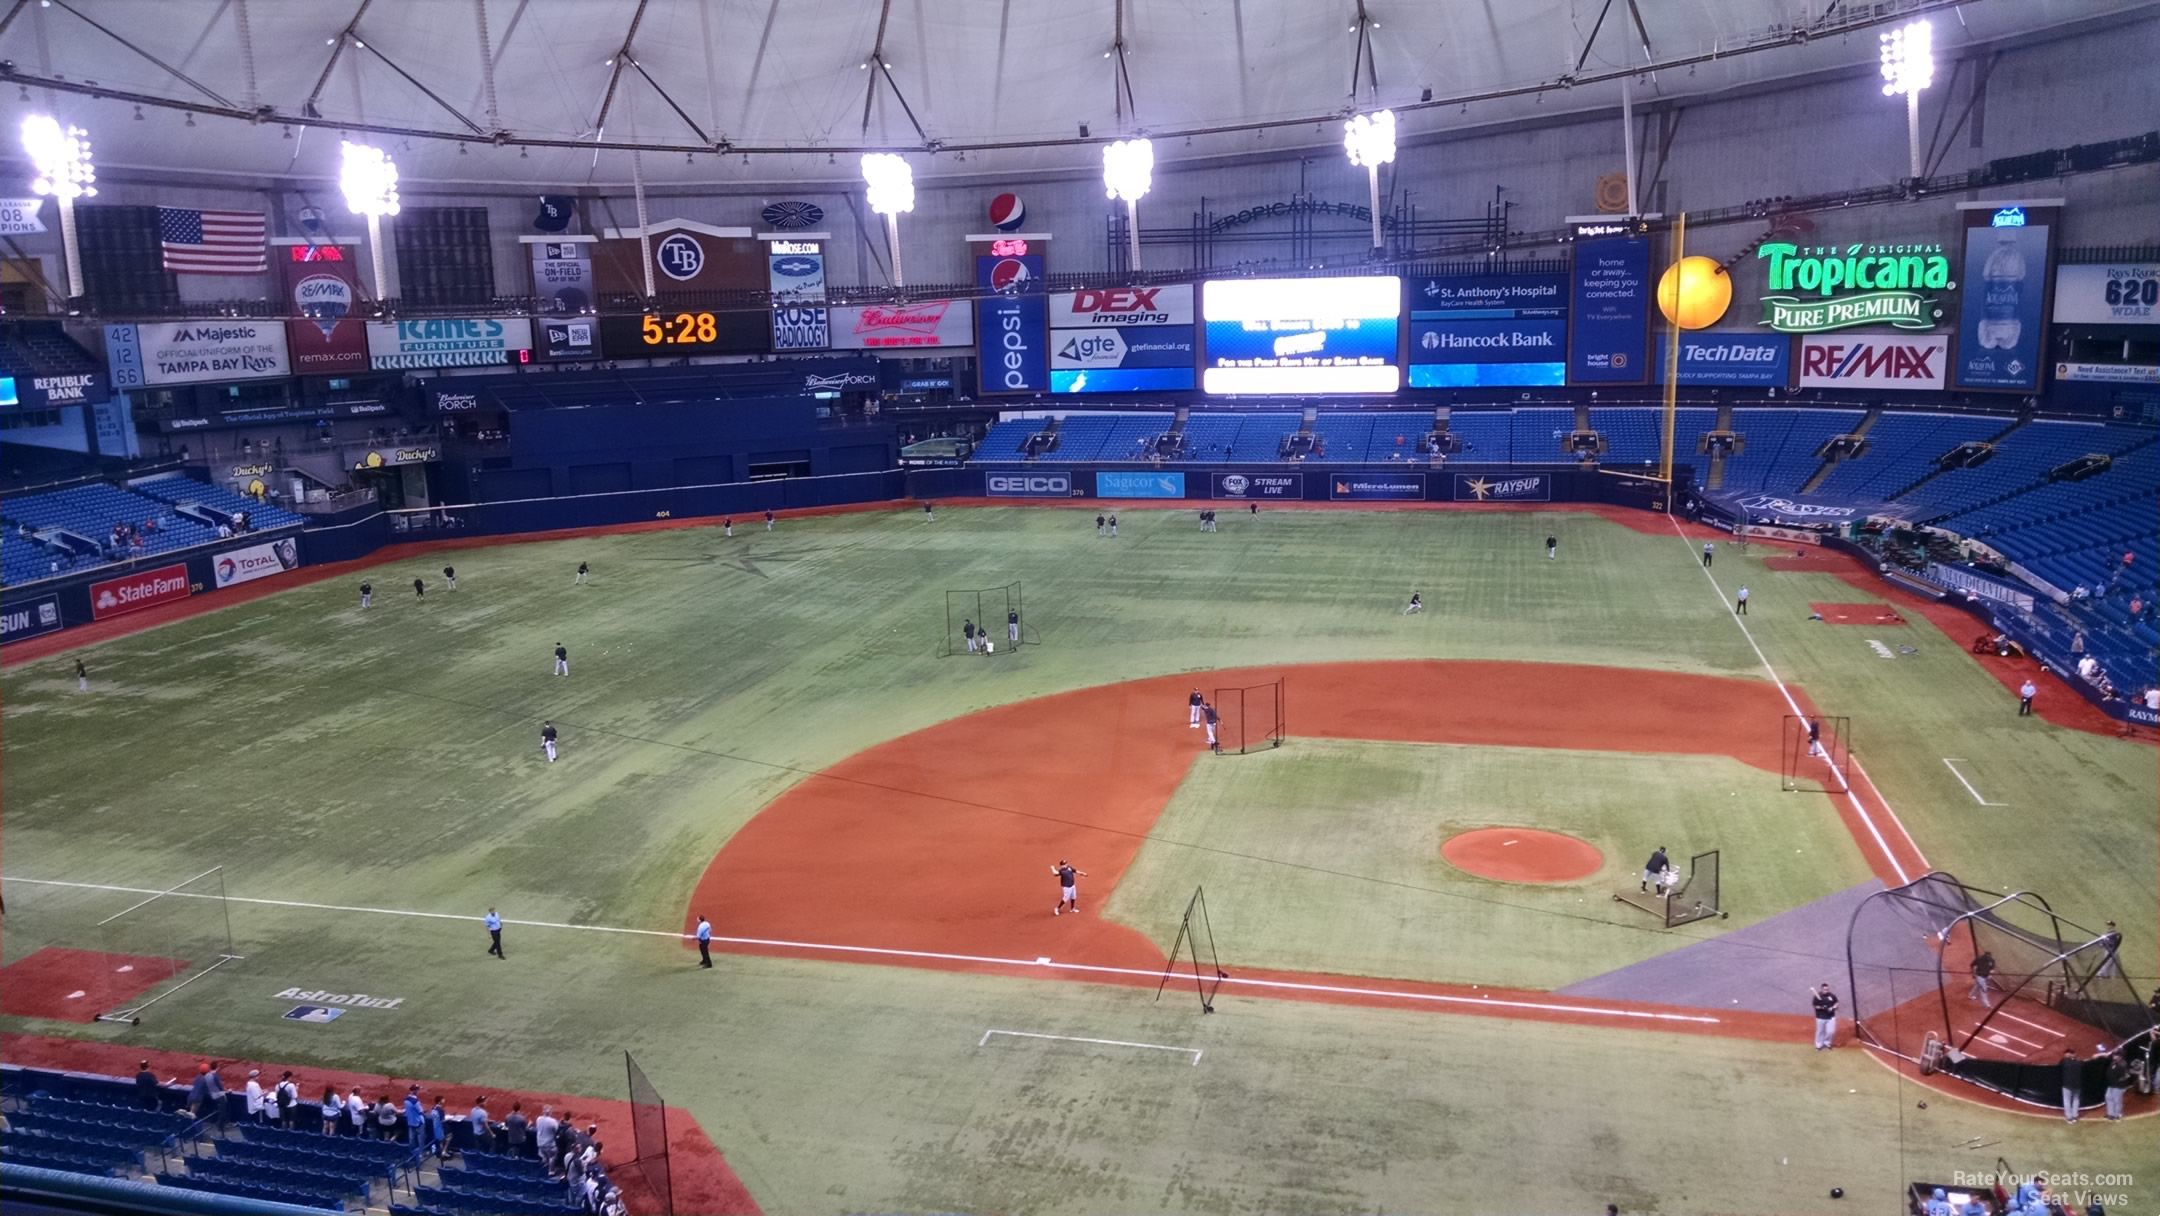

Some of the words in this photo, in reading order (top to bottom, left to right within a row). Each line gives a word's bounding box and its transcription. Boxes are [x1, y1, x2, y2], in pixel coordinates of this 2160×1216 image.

[1212, 200, 1332, 233] TROPICANA
[1578, 226, 1605, 236] bright
[1803, 247, 1837, 255] THE
[1869, 244, 1942, 254] ORIGINAL
[665, 243, 698, 271] TB
[1599, 258, 1625, 267] home
[545, 268, 581, 277] ON-FIELD
[1758, 243, 1949, 296] Tropicana
[302, 283, 345, 298] RE/MAX
[1584, 279, 1620, 289] keeping
[1621, 280, 1639, 289] you
[1441, 287, 1455, 297] St.
[1457, 287, 1510, 299] Anthony's
[1512, 285, 1557, 298] Hospital
[1586, 289, 1637, 298] connected.
[2105, 279, 2158, 306] 620
[1071, 288, 1162, 313] DEX
[775, 308, 826, 326] ROSE
[1091, 312, 1169, 324] imaging
[1773, 307, 1823, 326] PURE
[1827, 298, 1921, 324] PREMIUM
[2112, 307, 2151, 317] WDAE
[111, 328, 132, 342] 42
[196, 327, 256, 343] Majestic
[399, 320, 503, 340] KANES
[643, 312, 717, 344] 5:28
[775, 326, 827, 348] RADIOLOGY
[1441, 332, 1509, 348] Hancock
[1512, 332, 1554, 347] Bank
[157, 349, 199, 359] OFFICIAL
[200, 347, 241, 356] UNIFORM
[243, 346, 255, 354] OF
[257, 344, 273, 353] THE
[403, 340, 500, 351] FURNITURE
[997, 309, 1029, 389] pepsi
[1081, 335, 1115, 357] gte
[1131, 343, 1190, 352] gtefinancial.org
[117, 349, 133, 363] 12
[299, 353, 362, 363] remax.com
[1088, 353, 1118, 362] financial
[1802, 344, 1938, 379] RE/MAX
[159, 359, 209, 374] TAMPA
[212, 358, 239, 371] BAY
[240, 355, 277, 372] RAYS
[2095, 366, 2132, 375] Assistance?
[34, 375, 94, 390] REPUBLIC
[117, 369, 138, 384] 66
[845, 375, 876, 385] PORCH
[48, 387, 84, 400] BANK
[438, 399, 477, 410] PORCH
[397, 447, 436, 461] Ducky's
[232, 462, 273, 477] Ducky's
[989, 477, 1068, 492] GEICO
[1105, 474, 1154, 491] Sagicor
[1254, 478, 1292, 486] STREAM
[1652, 501, 1663, 510] 322
[239, 555, 276, 568] TOTAL
[191, 583, 203, 593] 370
[0, 611, 30, 634] SUN
[2129, 709, 2158, 723] RAYM
[273, 987, 406, 1009] AstroTurf
